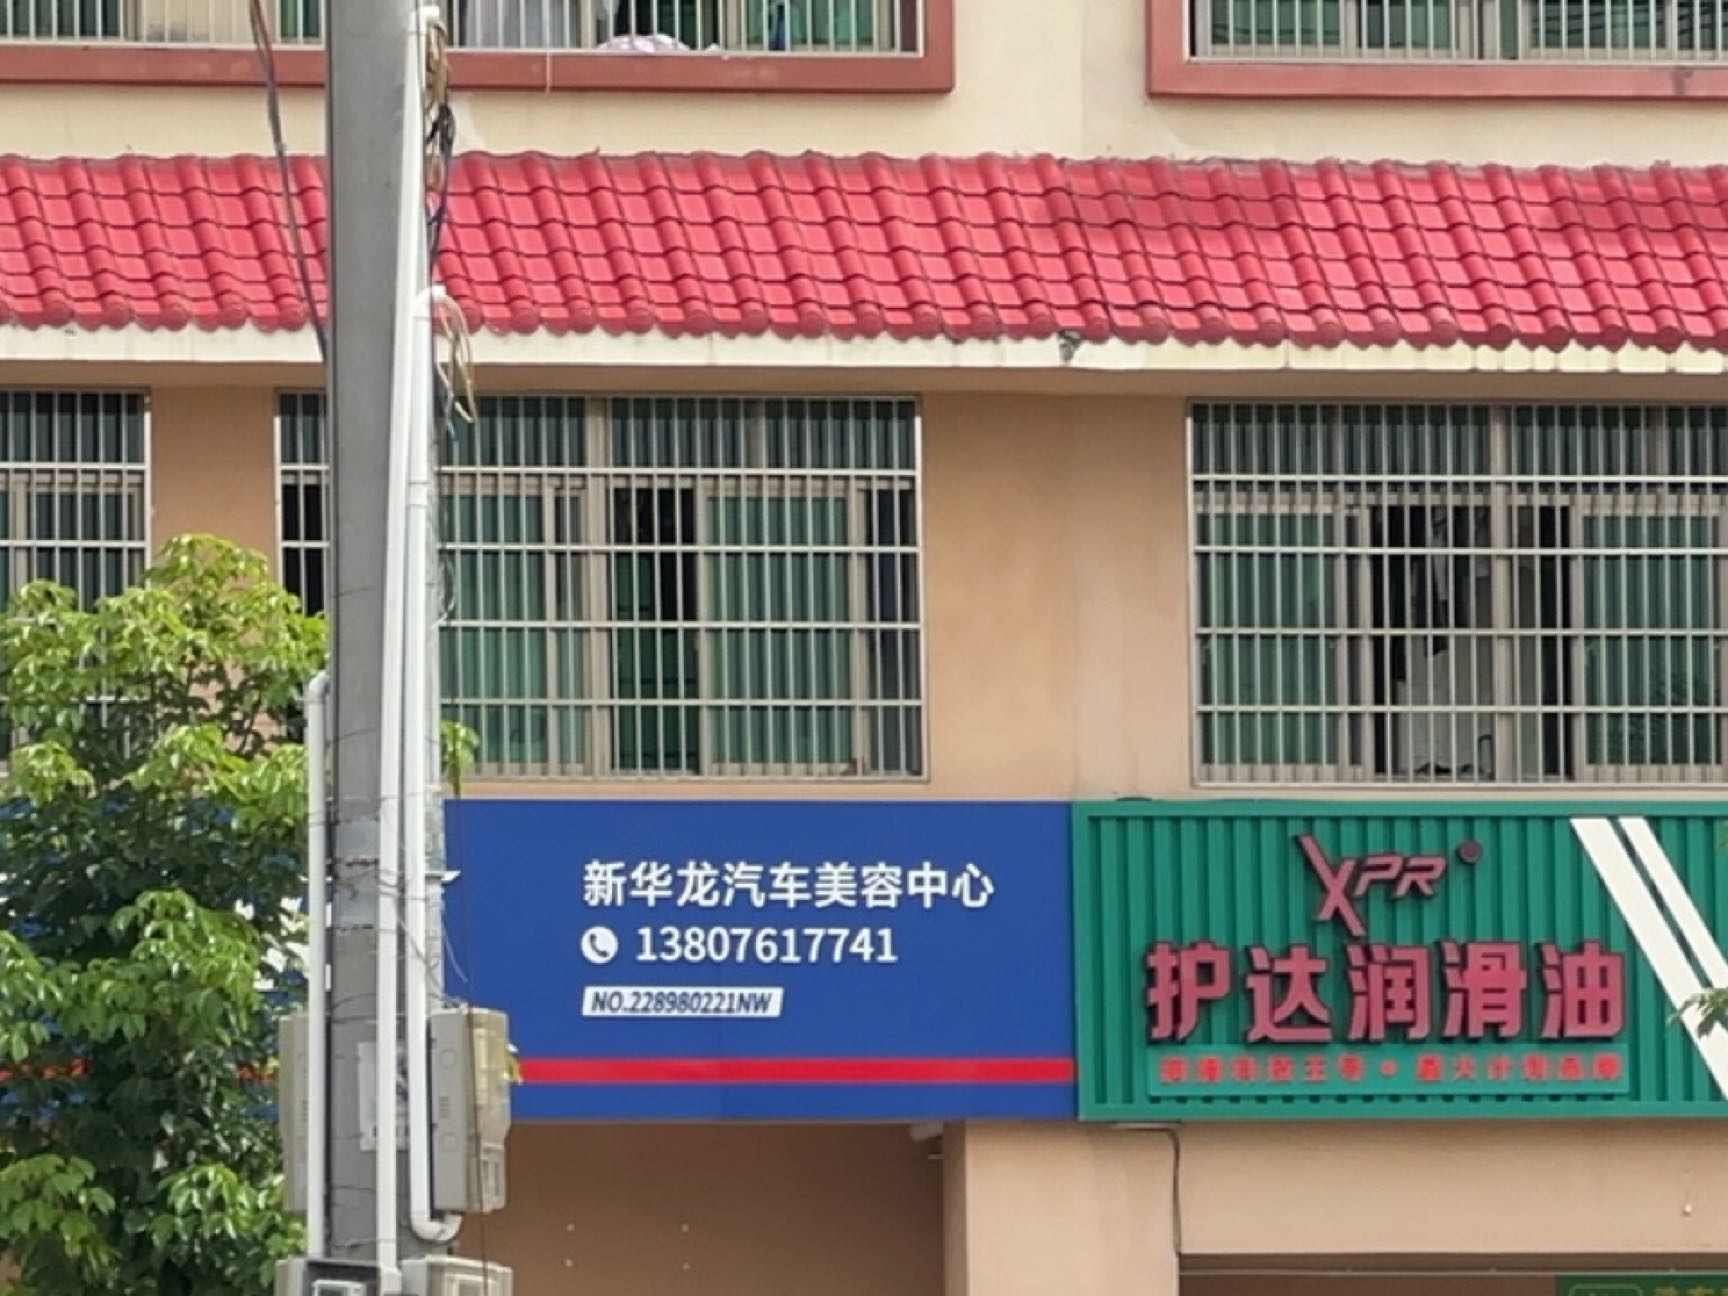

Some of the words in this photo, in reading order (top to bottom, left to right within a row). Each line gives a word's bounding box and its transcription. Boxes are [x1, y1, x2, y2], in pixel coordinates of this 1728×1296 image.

[583, 859, 995, 908] 新华龙汽车美容中心
[1295, 833, 1447, 937] XPR
[636, 926, 899, 964] 13807617741
[1144, 938, 1626, 1044] 护达润滑油
